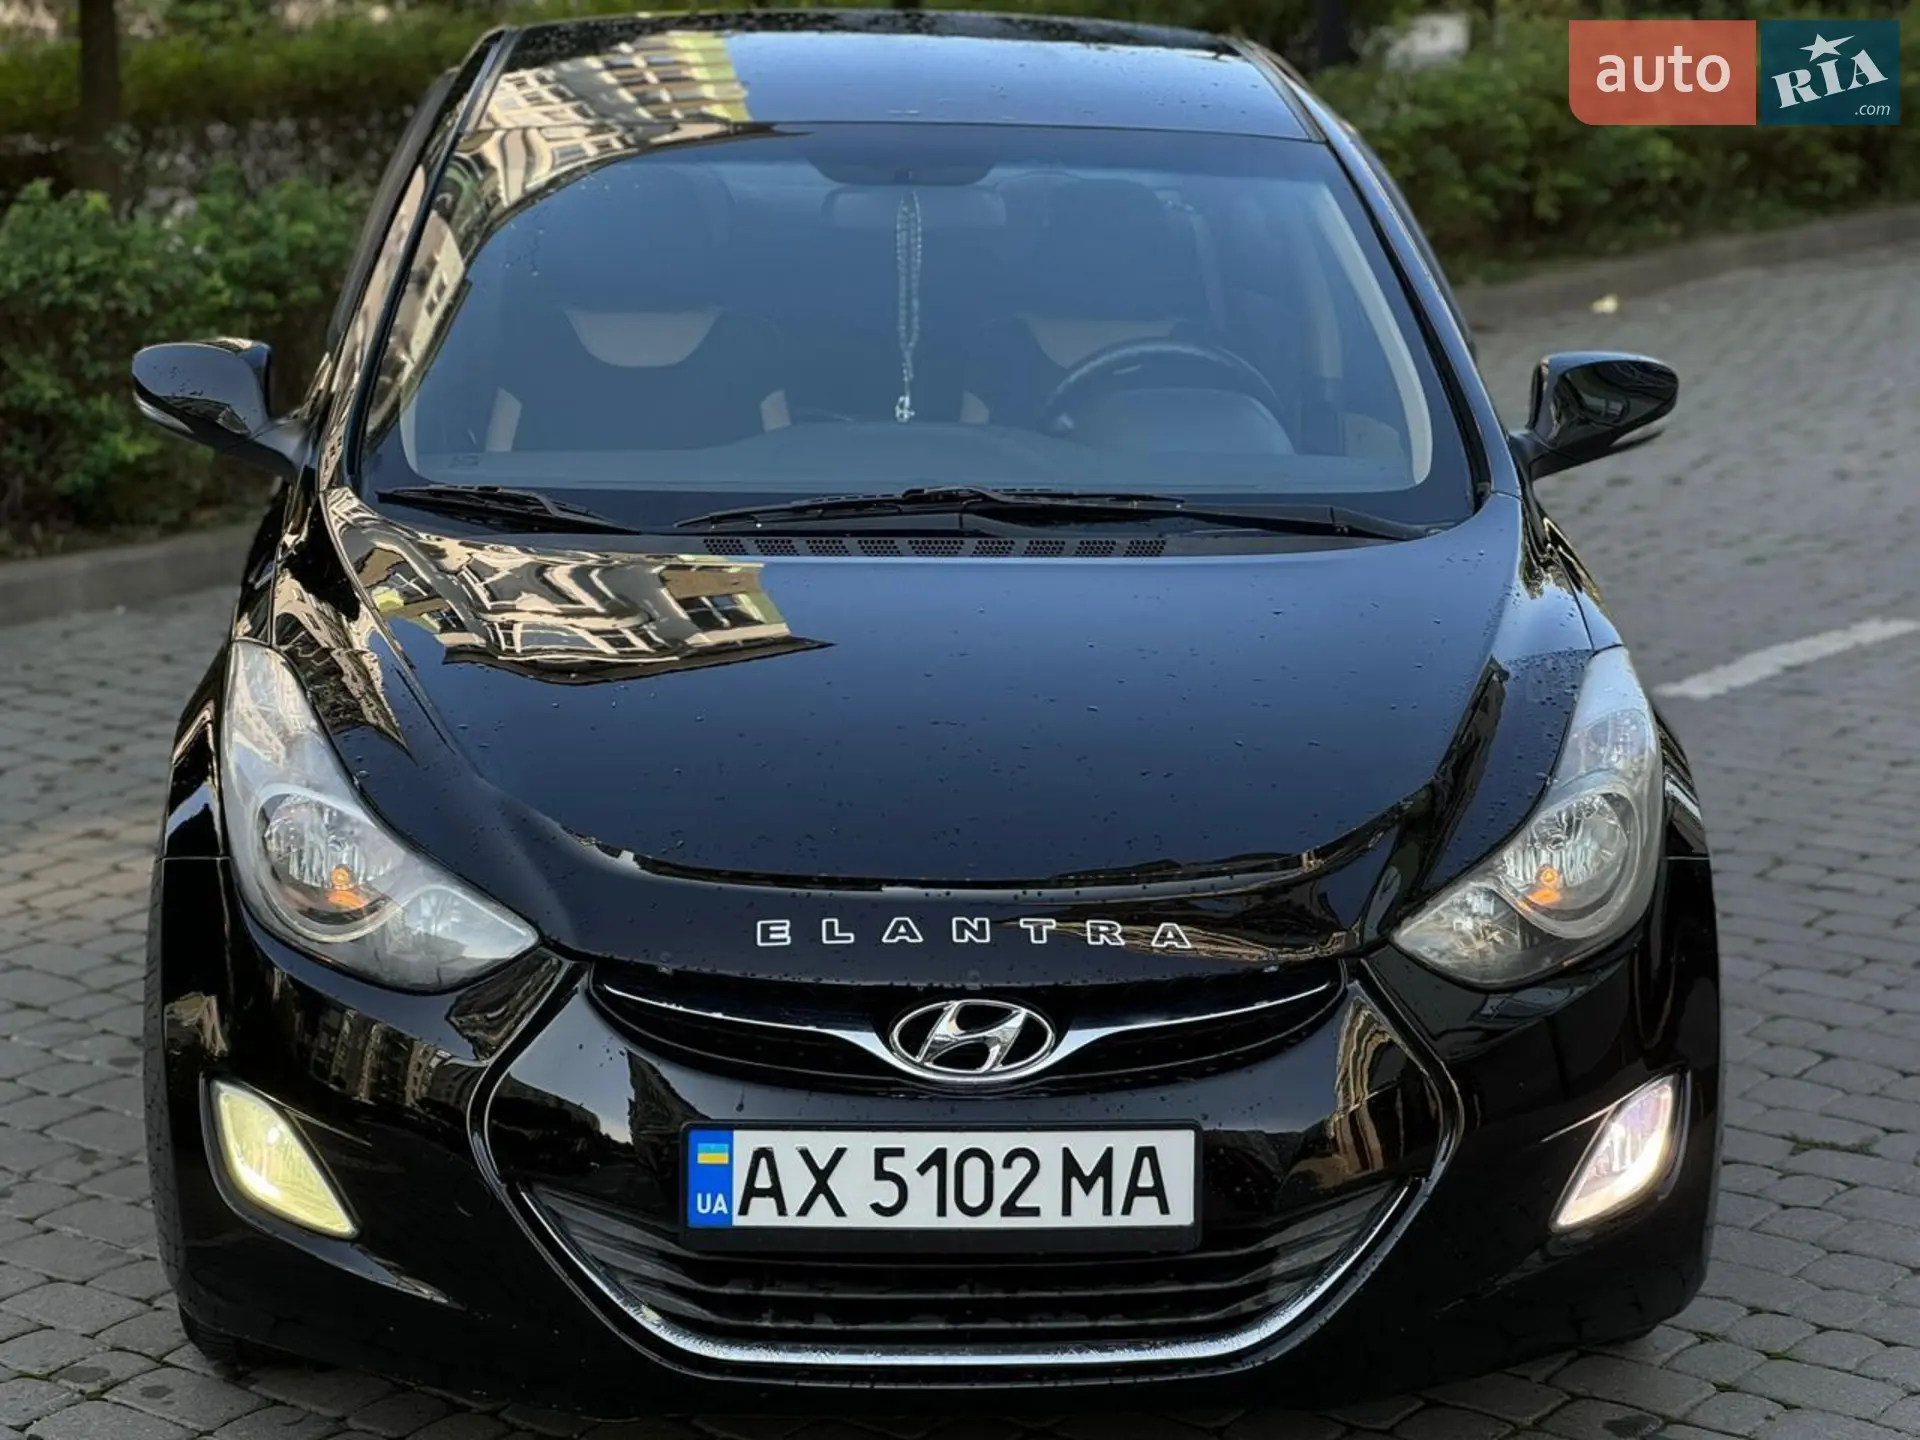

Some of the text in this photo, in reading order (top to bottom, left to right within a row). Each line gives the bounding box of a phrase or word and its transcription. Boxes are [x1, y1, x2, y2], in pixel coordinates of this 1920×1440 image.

[756, 917, 1192, 948] ELANTRA
[737, 1145, 1172, 1218] AX 5102 MA
[696, 1192, 729, 1214] UA
